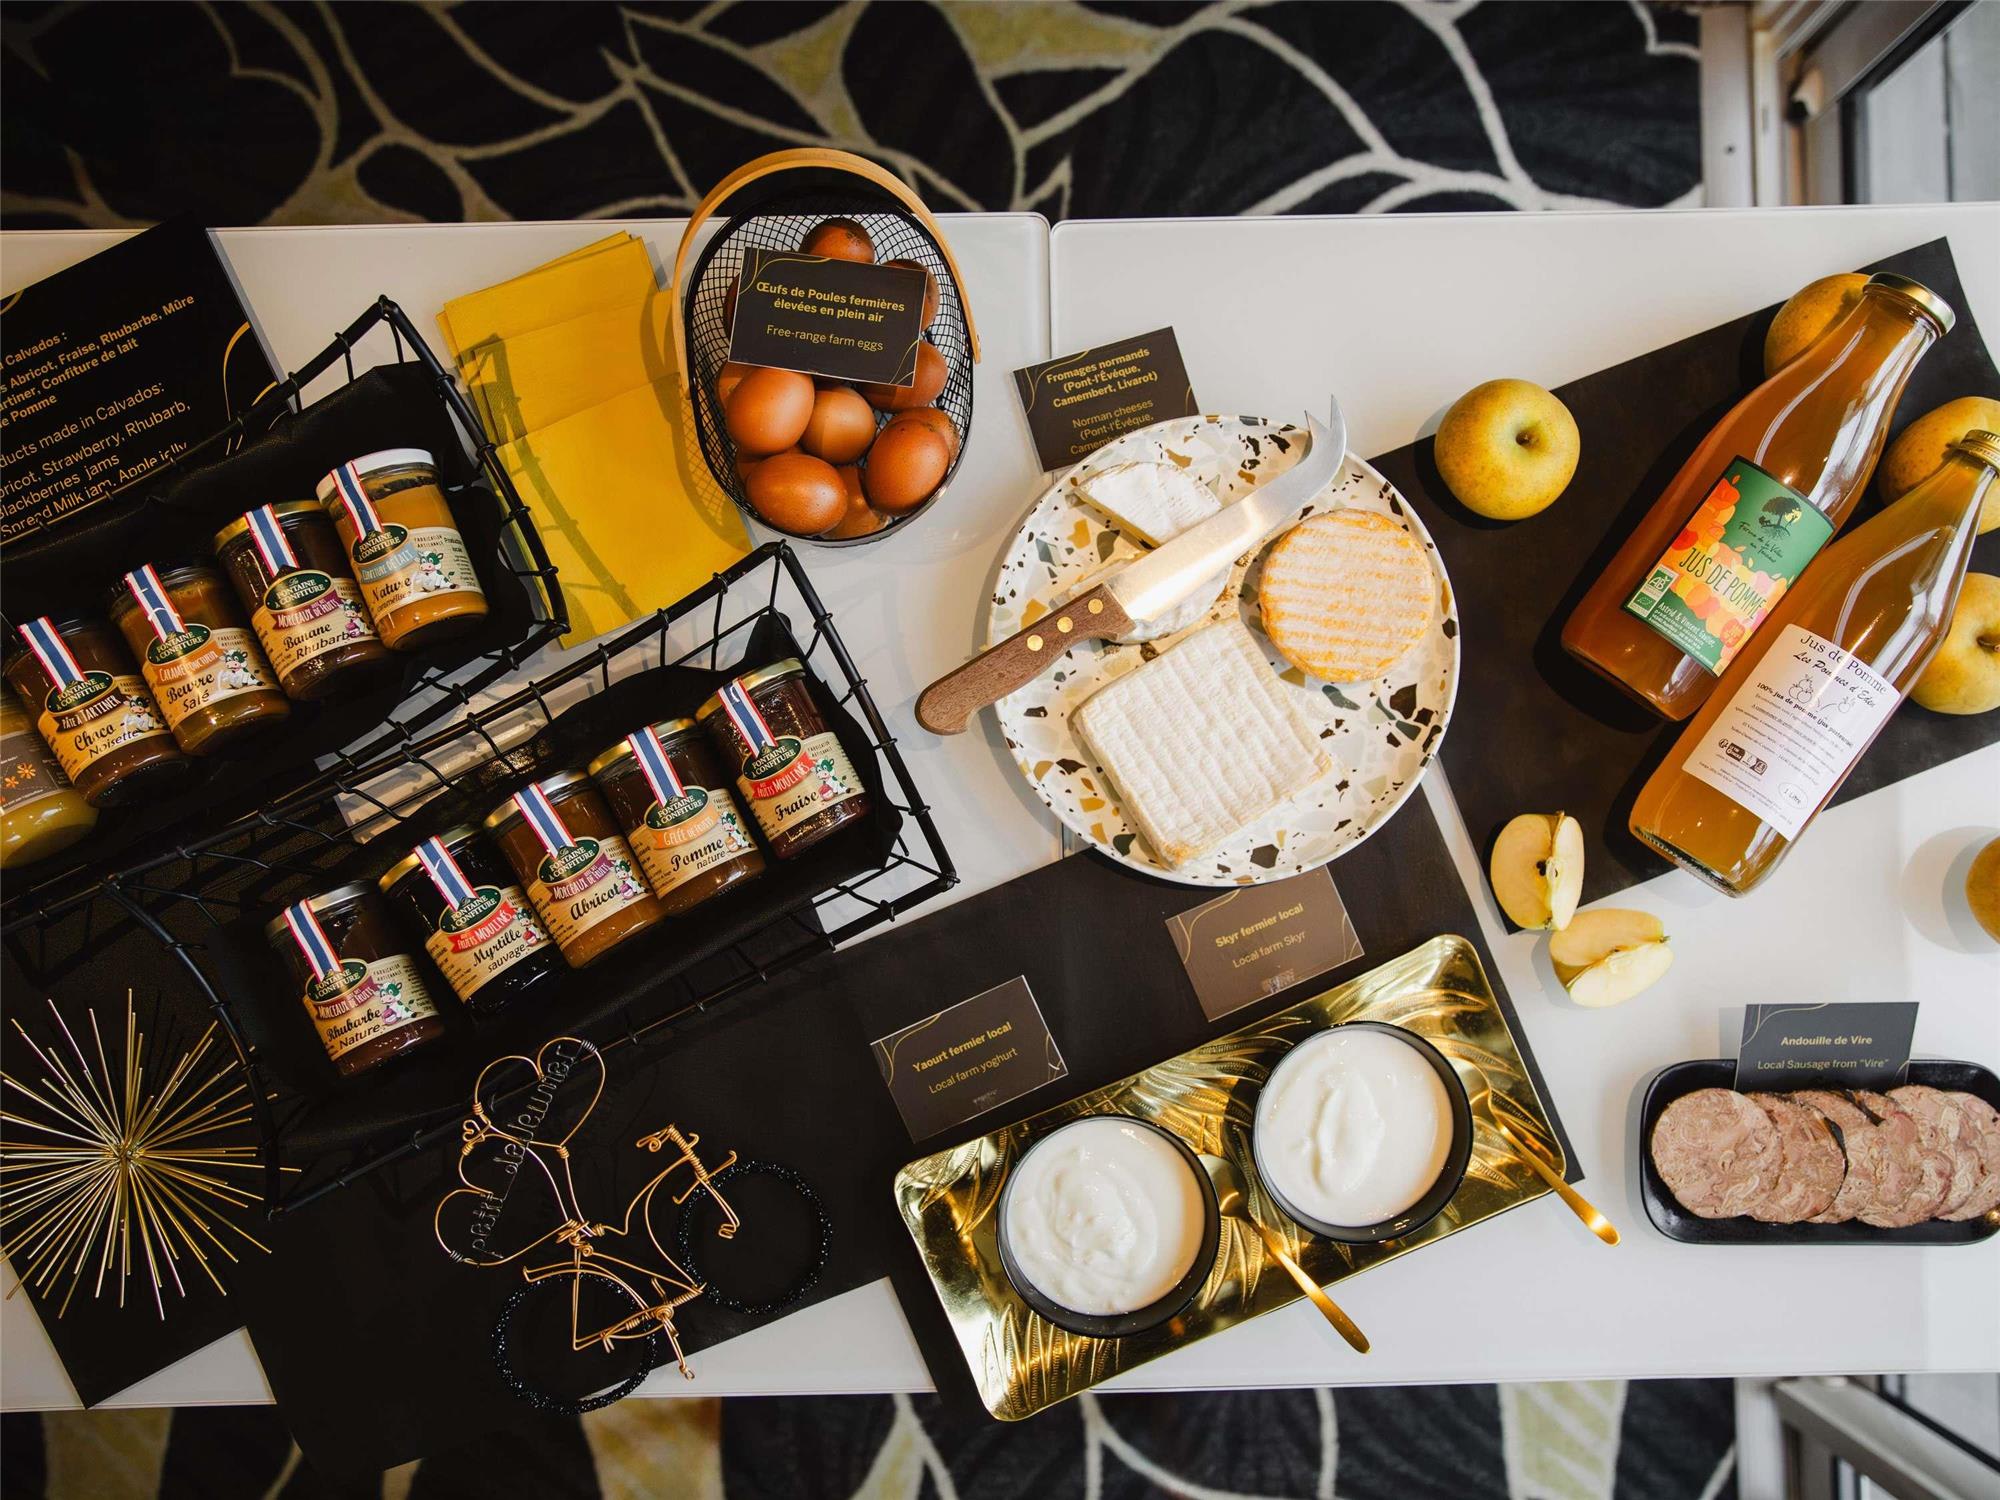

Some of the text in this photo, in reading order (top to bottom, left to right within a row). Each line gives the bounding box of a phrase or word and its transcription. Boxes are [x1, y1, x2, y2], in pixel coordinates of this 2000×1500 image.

[756, 282, 905, 312] Œufs de Poules fermières
[773, 298, 884, 323] élevées en plein air
[5, 336, 60, 365] Calvados
[10, 296, 194, 389] Abricot, Fraise, Rhubarbe, Mûre
[766, 325, 884, 352] Free-range farm eggs
[42, 338, 139, 390] Confiture de lait
[1046, 348, 1150, 384] Fromages normands
[1053, 370, 1158, 408] Camembert, Livarot)
[10, 395, 57, 422] Pomme
[40, 423, 79, 449] made
[80, 416, 95, 429] in
[96, 382, 164, 420] Calvados:
[1072, 400, 1153, 428] Norman cheeses
[42, 401, 190, 476] Strawberry, Rhubarb,
[84, 455, 120, 480] jams
[53, 491, 84, 514] Milk
[359, 531, 393, 552] FONTAINE
[362, 536, 400, 560] CONFITURE
[276, 579, 315, 599] FONTAINE
[280, 584, 325, 607] CONFITURE
[1679, 547, 1712, 578] JUS
[1706, 564, 1732, 592] DE
[1724, 574, 1767, 620] POMME
[278, 608, 315, 628] MORCEAUX
[157, 631, 193, 652] FONTAINE
[159, 636, 203, 660] CONFITURE
[283, 623, 331, 651] Banane
[296, 630, 356, 660] Rhubarbe
[1793, 652, 1811, 667] Les
[1801, 635, 1887, 695] Jus de Pomme
[57, 678, 97, 702] FONTAINE
[61, 682, 106, 708] CONFITURE
[167, 673, 214, 704] Beurre
[1757, 682, 1773, 693] 100%
[1773, 691, 1784, 700] jus
[81, 694, 121, 722] TARTINER
[89, 728, 141, 758] Noisette
[752, 745, 788, 770] FONTAINE
[756, 749, 796, 776] CONFITURE
[774, 761, 810, 792] MOULINÉS
[657, 795, 695, 818] FONTAINE
[660, 800, 703, 825] CONFITURE
[775, 790, 819, 821] Fraise
[550, 847, 586, 871] FONTAINE
[553, 850, 595, 877] CONFITURE
[671, 838, 724, 872] Pomme
[696, 850, 726, 870] nature
[553, 879, 588, 900] MORCEAUX
[570, 883, 620, 920] Abricot
[451, 895, 488, 921] FONTAINE
[455, 898, 497, 927] CONFITURE
[474, 909, 512, 943] MOULINÉS
[1215, 903, 1304, 948] Skyr fermier local
[473, 929, 522, 968] Myrtille
[488, 943, 526, 973] sauvage
[1232, 931, 1306, 968] Local farm Skyr
[316, 968, 351, 991] FONTAINE
[317, 972, 361, 997] CONFITURE
[326, 1008, 382, 1041] Rhubarbe
[339, 1023, 381, 1050] Nature
[912, 1021, 1012, 1073] Yaourt fermier local
[1781, 1035, 1872, 1046] Andouille de Vire
[928, 1047, 1018, 1094] Local farm yoghurt
[1758, 1060, 1785, 1070] Local
[1788, 1060, 1830, 1070] Sausage
[1832, 1059, 1857, 1068] from
